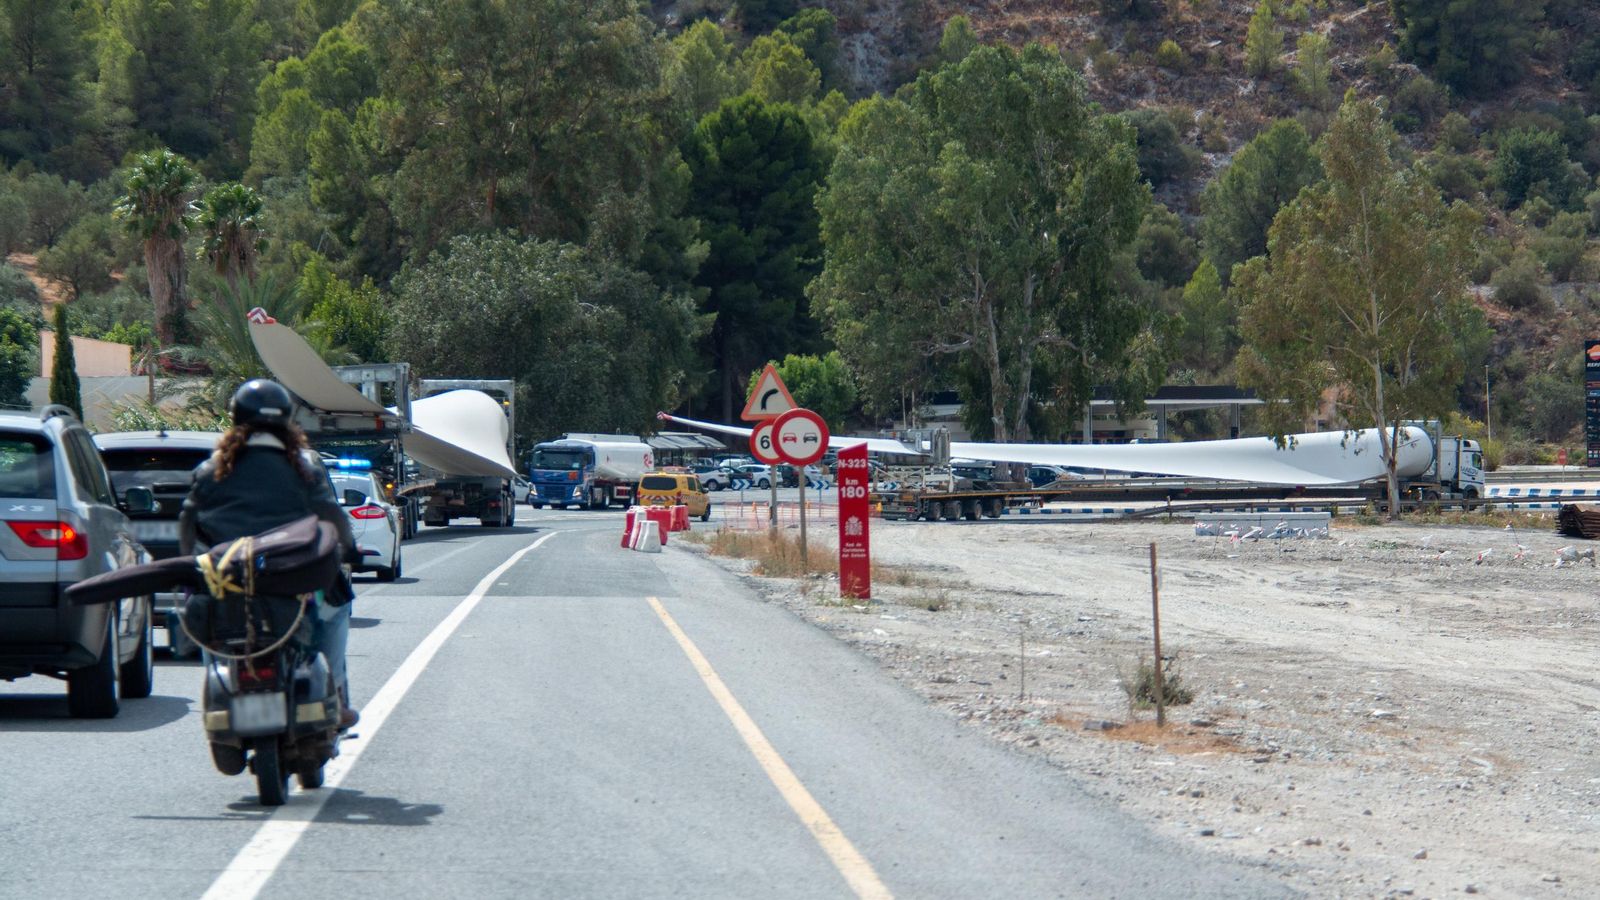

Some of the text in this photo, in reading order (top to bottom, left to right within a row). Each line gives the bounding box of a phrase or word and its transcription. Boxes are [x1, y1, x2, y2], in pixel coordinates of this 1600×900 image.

[838, 458, 867, 468] N-323
[845, 477, 859, 486] km
[840, 486, 865, 498] 180
[9, 504, 44, 512] X3
